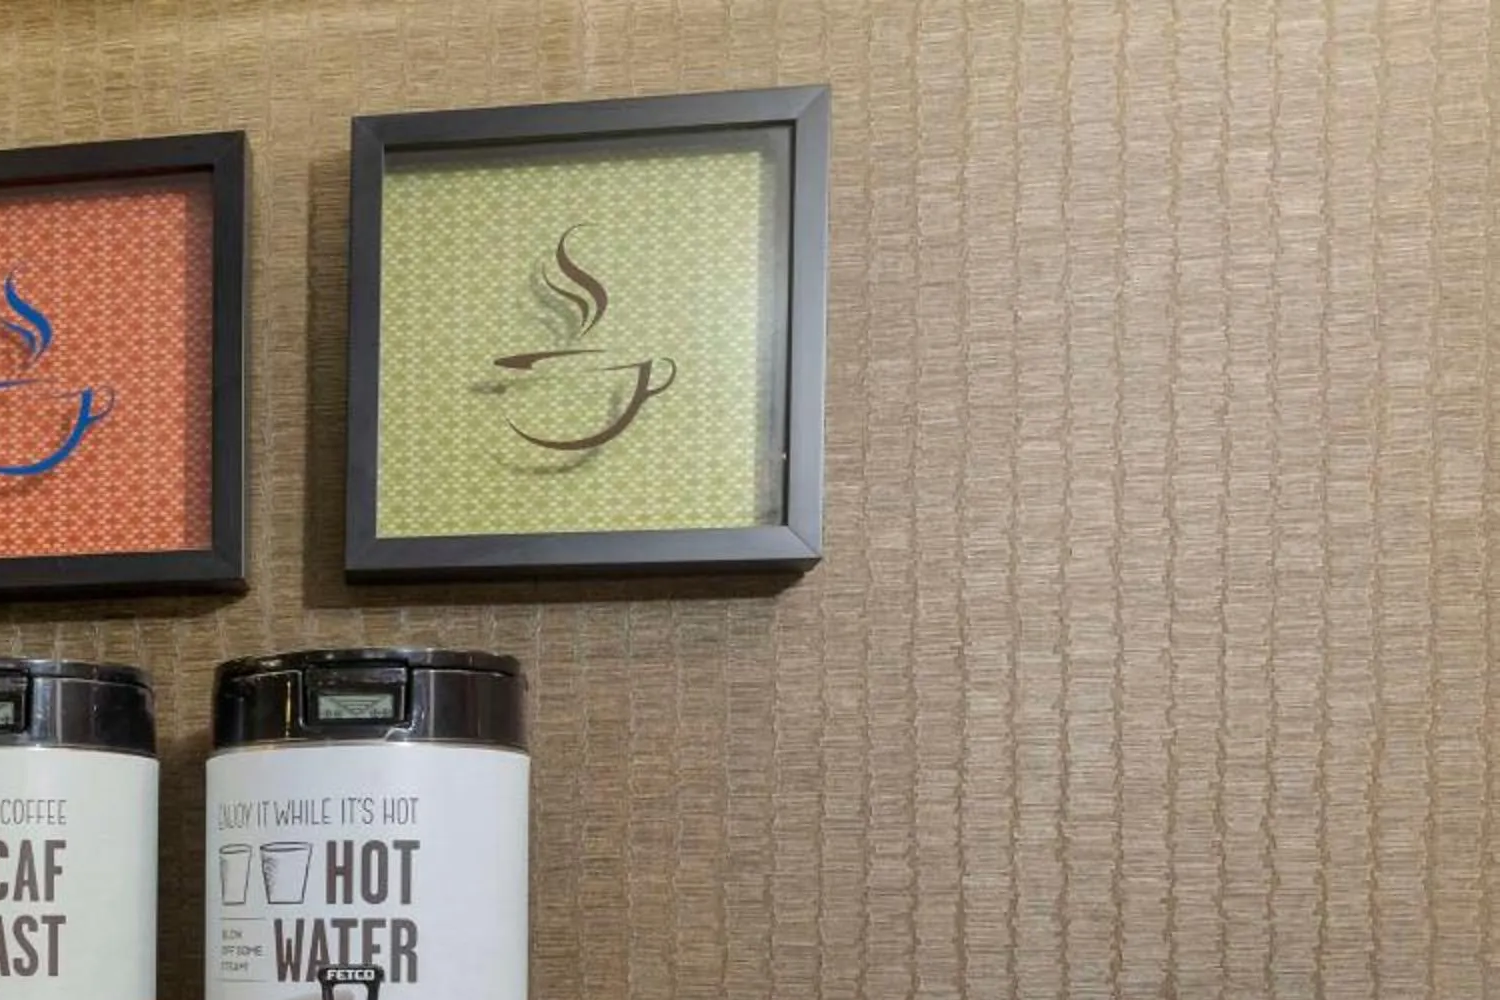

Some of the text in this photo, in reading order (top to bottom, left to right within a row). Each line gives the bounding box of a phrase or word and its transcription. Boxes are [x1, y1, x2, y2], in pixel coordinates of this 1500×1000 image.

[0, 799, 68, 826] COFFEE
[257, 800, 270, 828] IT
[273, 797, 334, 827] WHILE
[341, 797, 376, 826] IT'S
[382, 797, 420, 826] HOT
[325, 839, 421, 905] HOT
[273, 918, 419, 984] WATER
[326, 968, 376, 981] FETCO
